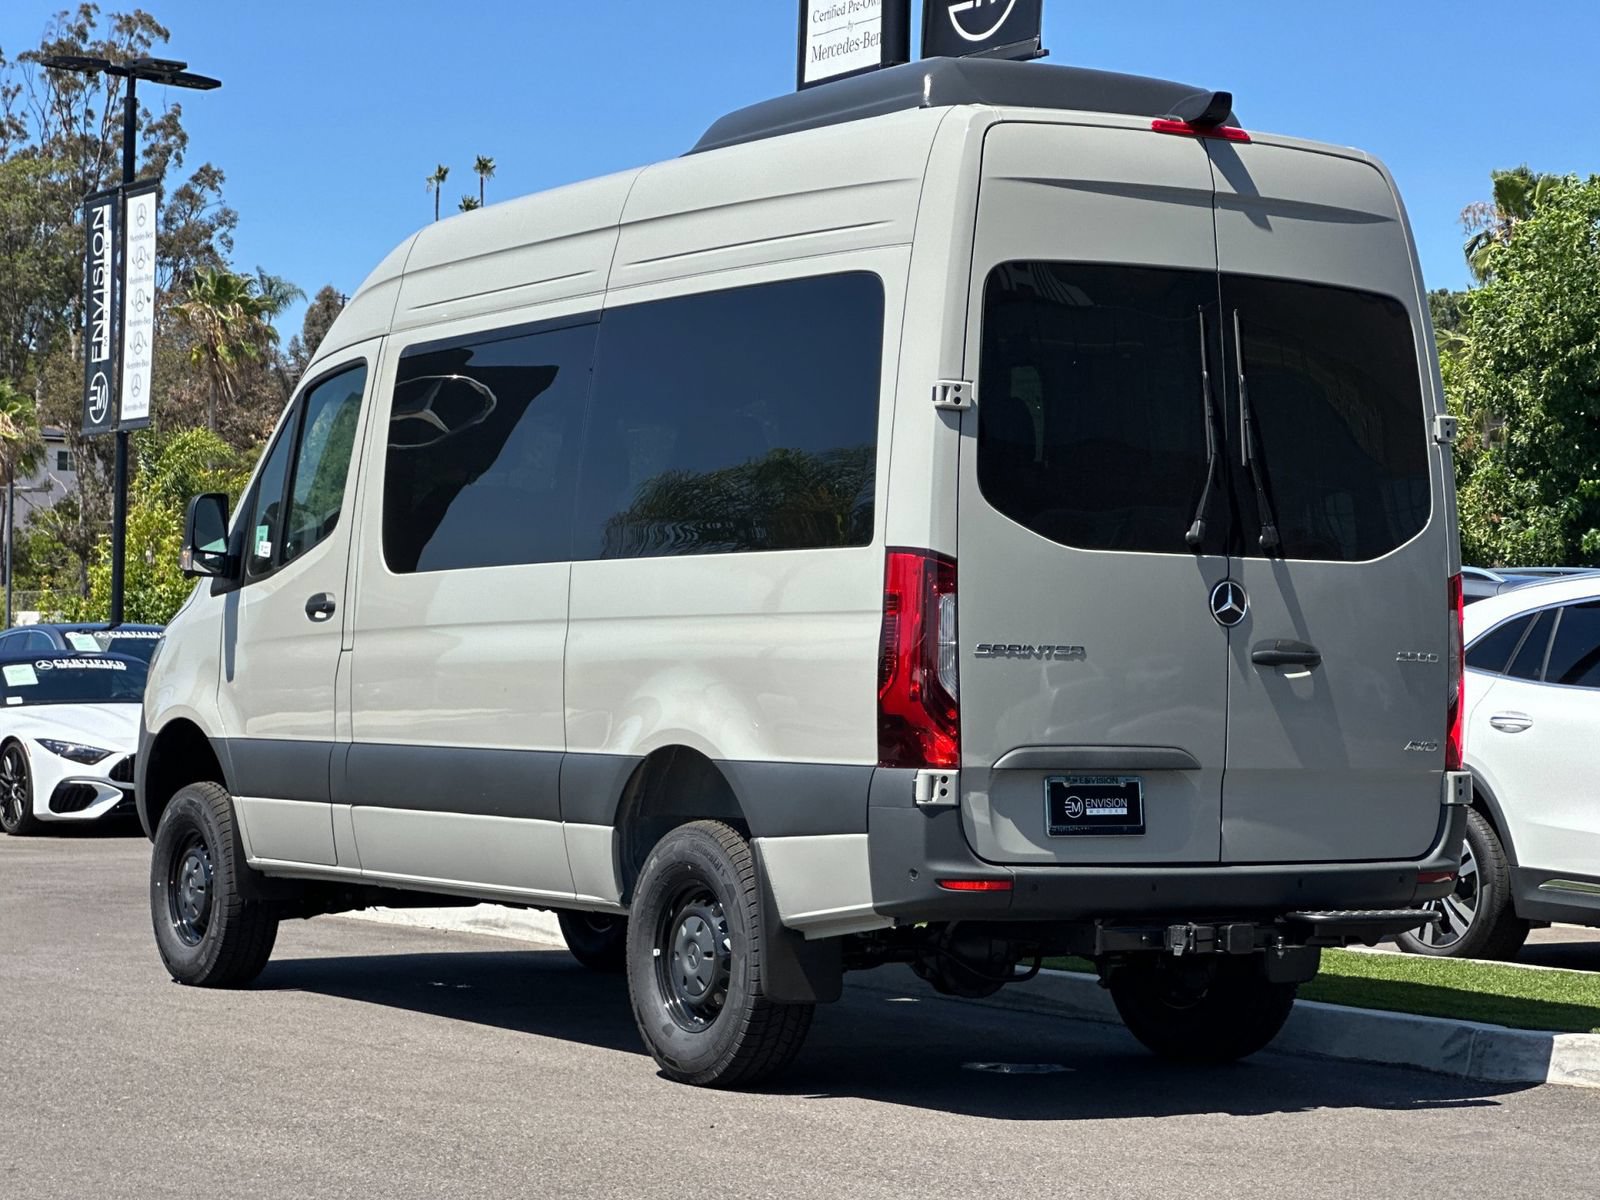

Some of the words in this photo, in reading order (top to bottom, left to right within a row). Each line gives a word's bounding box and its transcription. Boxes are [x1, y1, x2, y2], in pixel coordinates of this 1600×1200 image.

[813, 2, 846, 23] Certified
[92, 207, 104, 362] ENVISION
[974, 644, 1086, 661] SPRINTER
[53, 659, 126, 668] CERTIFIED
[1085, 798, 1128, 808] ENVISION
